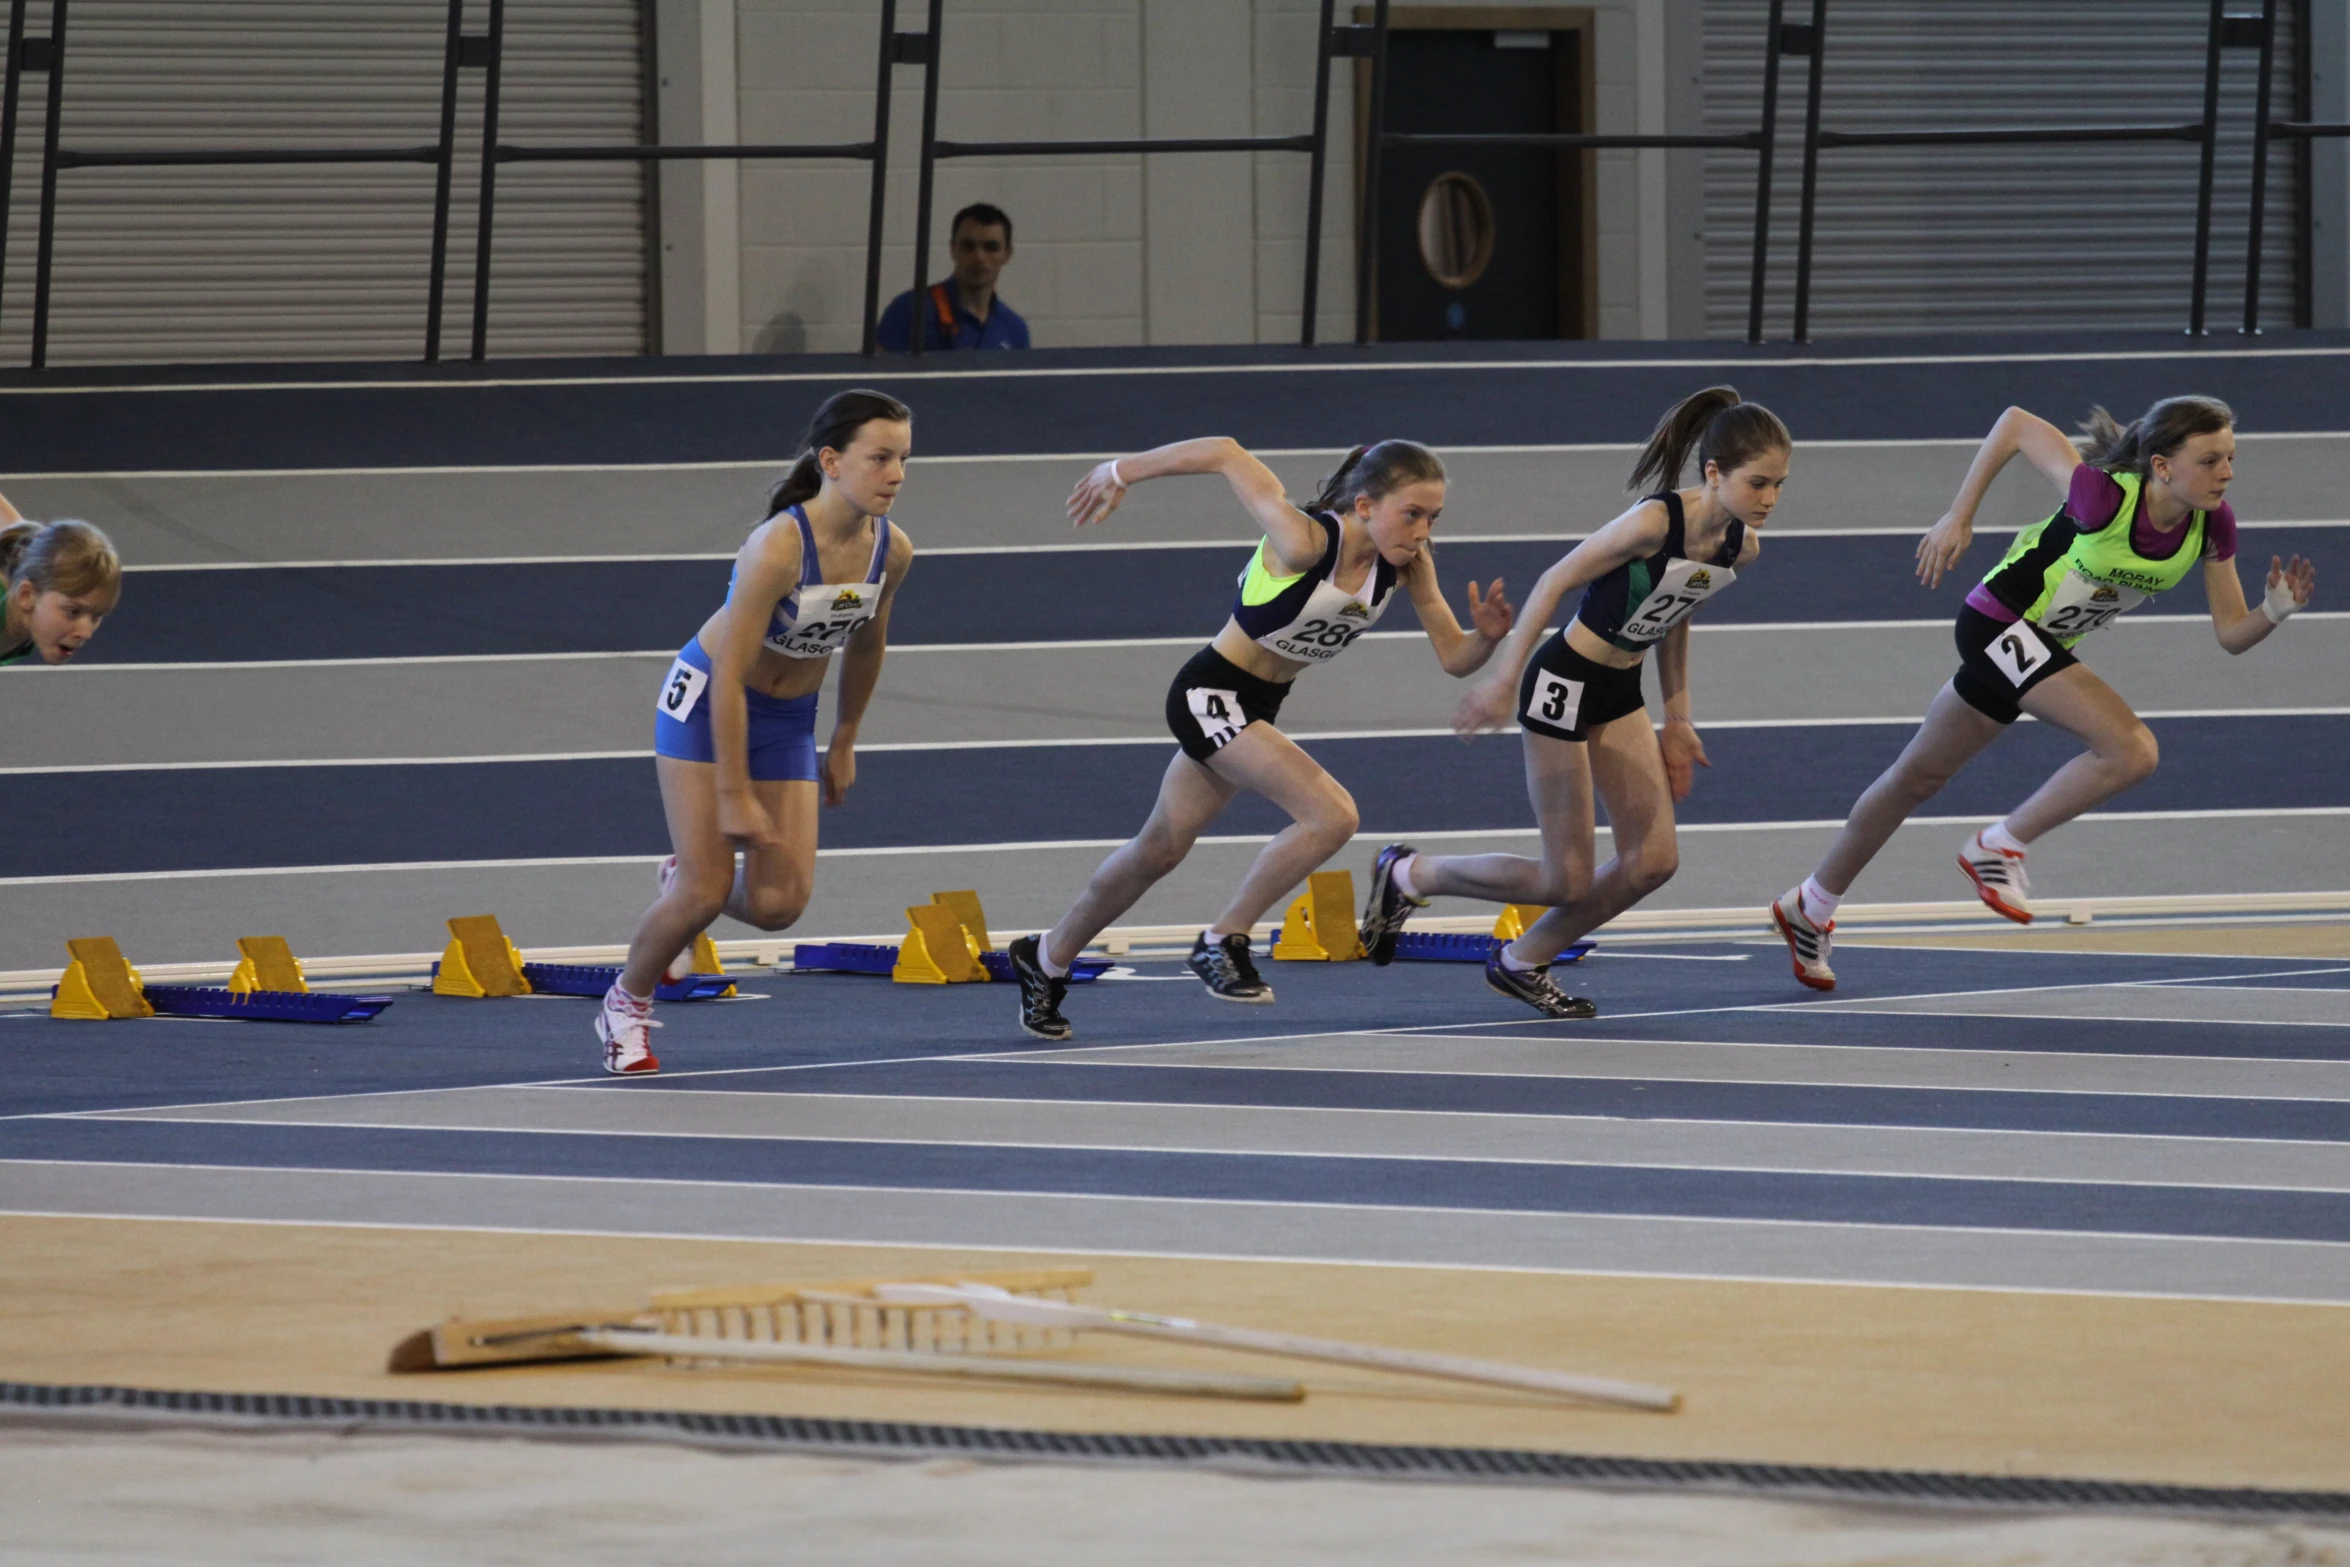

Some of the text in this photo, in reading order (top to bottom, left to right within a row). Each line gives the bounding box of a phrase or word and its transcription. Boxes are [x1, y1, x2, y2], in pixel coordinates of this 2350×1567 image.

[2108, 568, 2165, 586] MORAY
[1641, 593, 1702, 624] 27
[1627, 622, 1671, 637] GLAS
[2001, 634, 2037, 674] 2
[666, 667, 693, 711] 5
[1542, 681, 1568, 721] 3
[1206, 694, 1231, 720] 4
